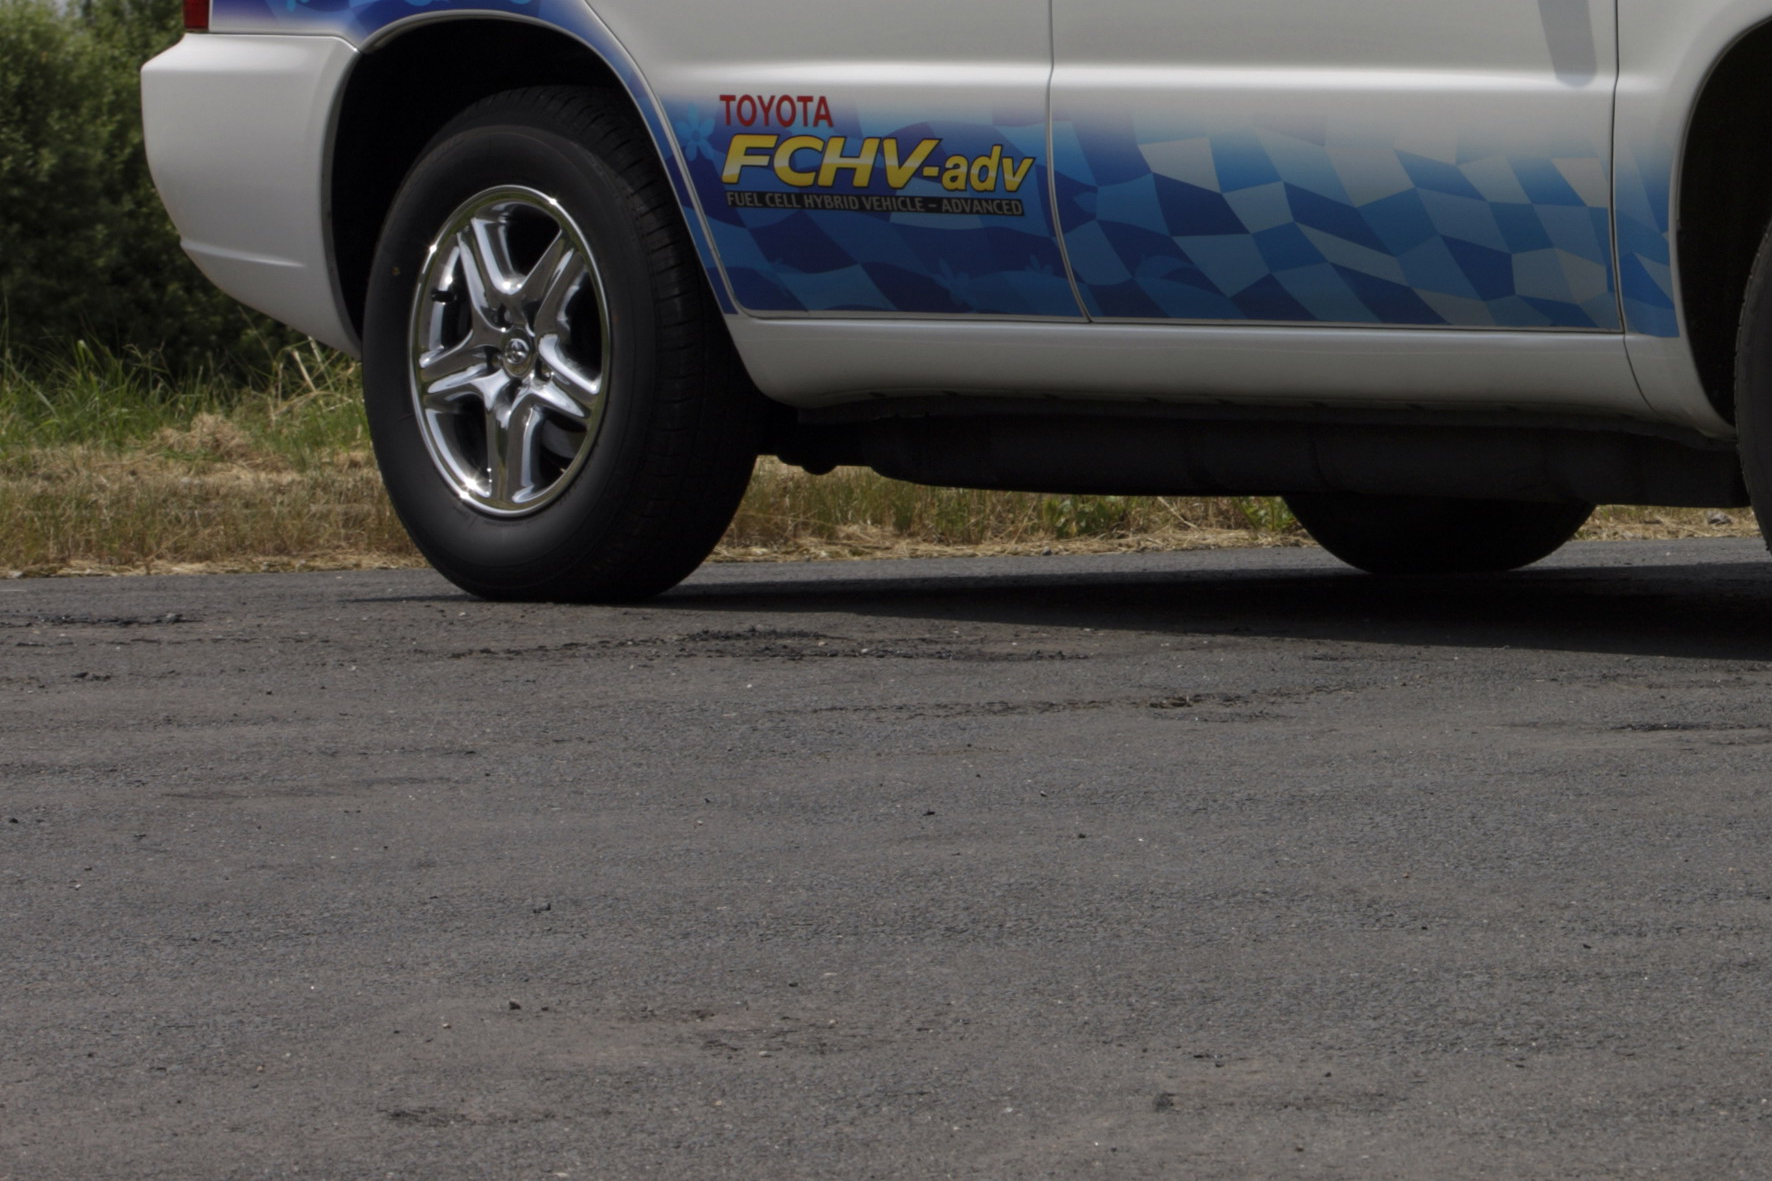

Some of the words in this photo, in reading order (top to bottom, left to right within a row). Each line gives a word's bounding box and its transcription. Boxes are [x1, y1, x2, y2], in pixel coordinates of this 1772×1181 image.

[719, 94, 834, 128] TOYOTA
[721, 133, 1036, 193] FCHV-adv
[726, 191, 763, 207] FUEL
[765, 193, 801, 209] CELL
[804, 194, 860, 210] HYBRID
[861, 196, 925, 212] VEHICLE
[941, 198, 1023, 215] ADVANCED
